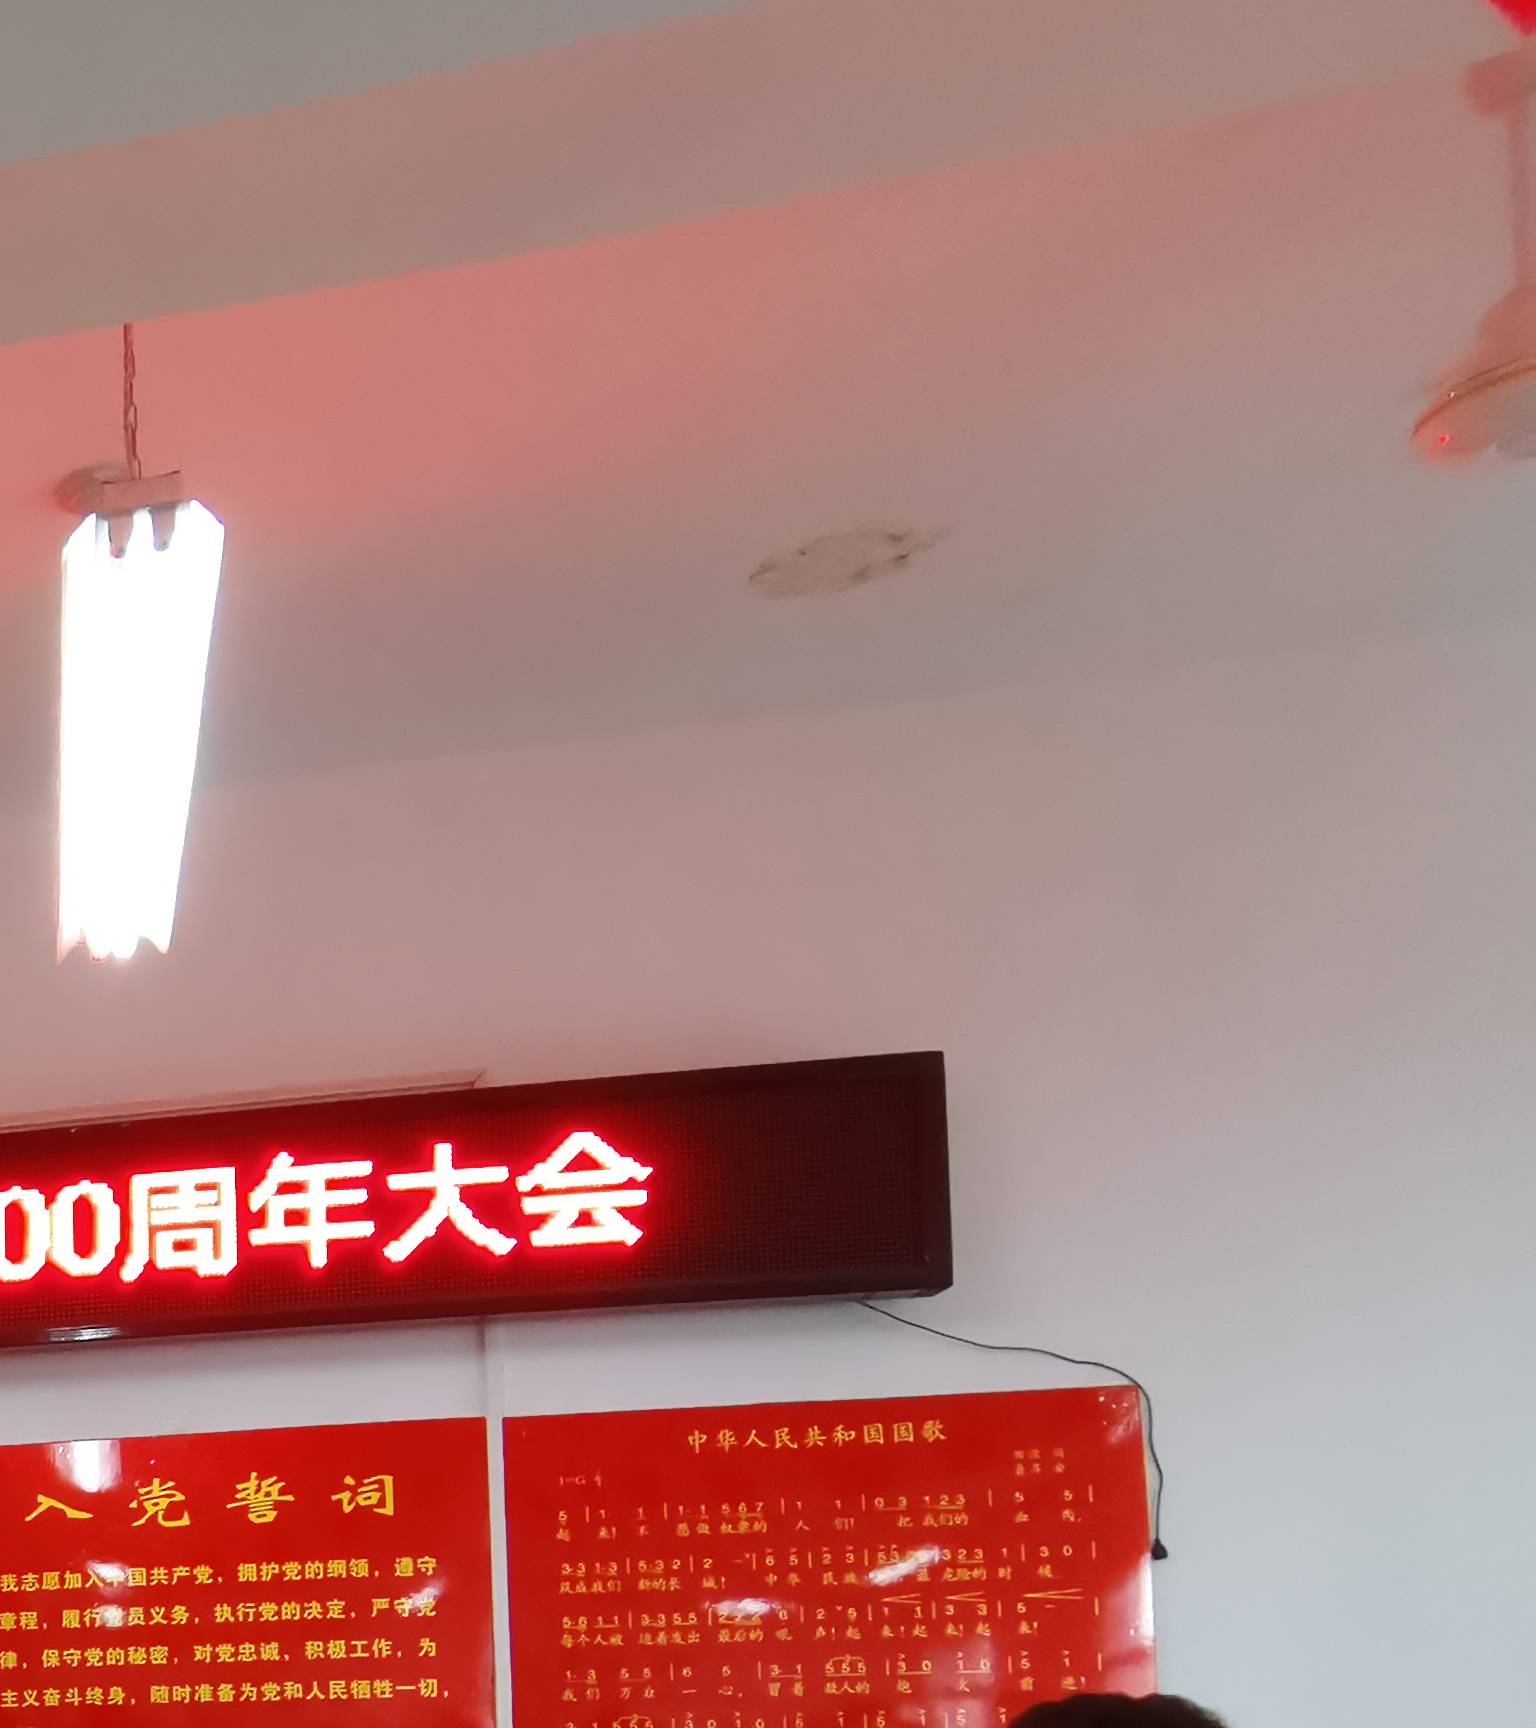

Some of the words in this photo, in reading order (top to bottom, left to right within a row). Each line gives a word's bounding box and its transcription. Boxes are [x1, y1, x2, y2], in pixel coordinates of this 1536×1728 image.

[687, 1420, 947, 1451] 中华人民共和国国歌
[24, 1473, 396, 1528] 入党誓词
